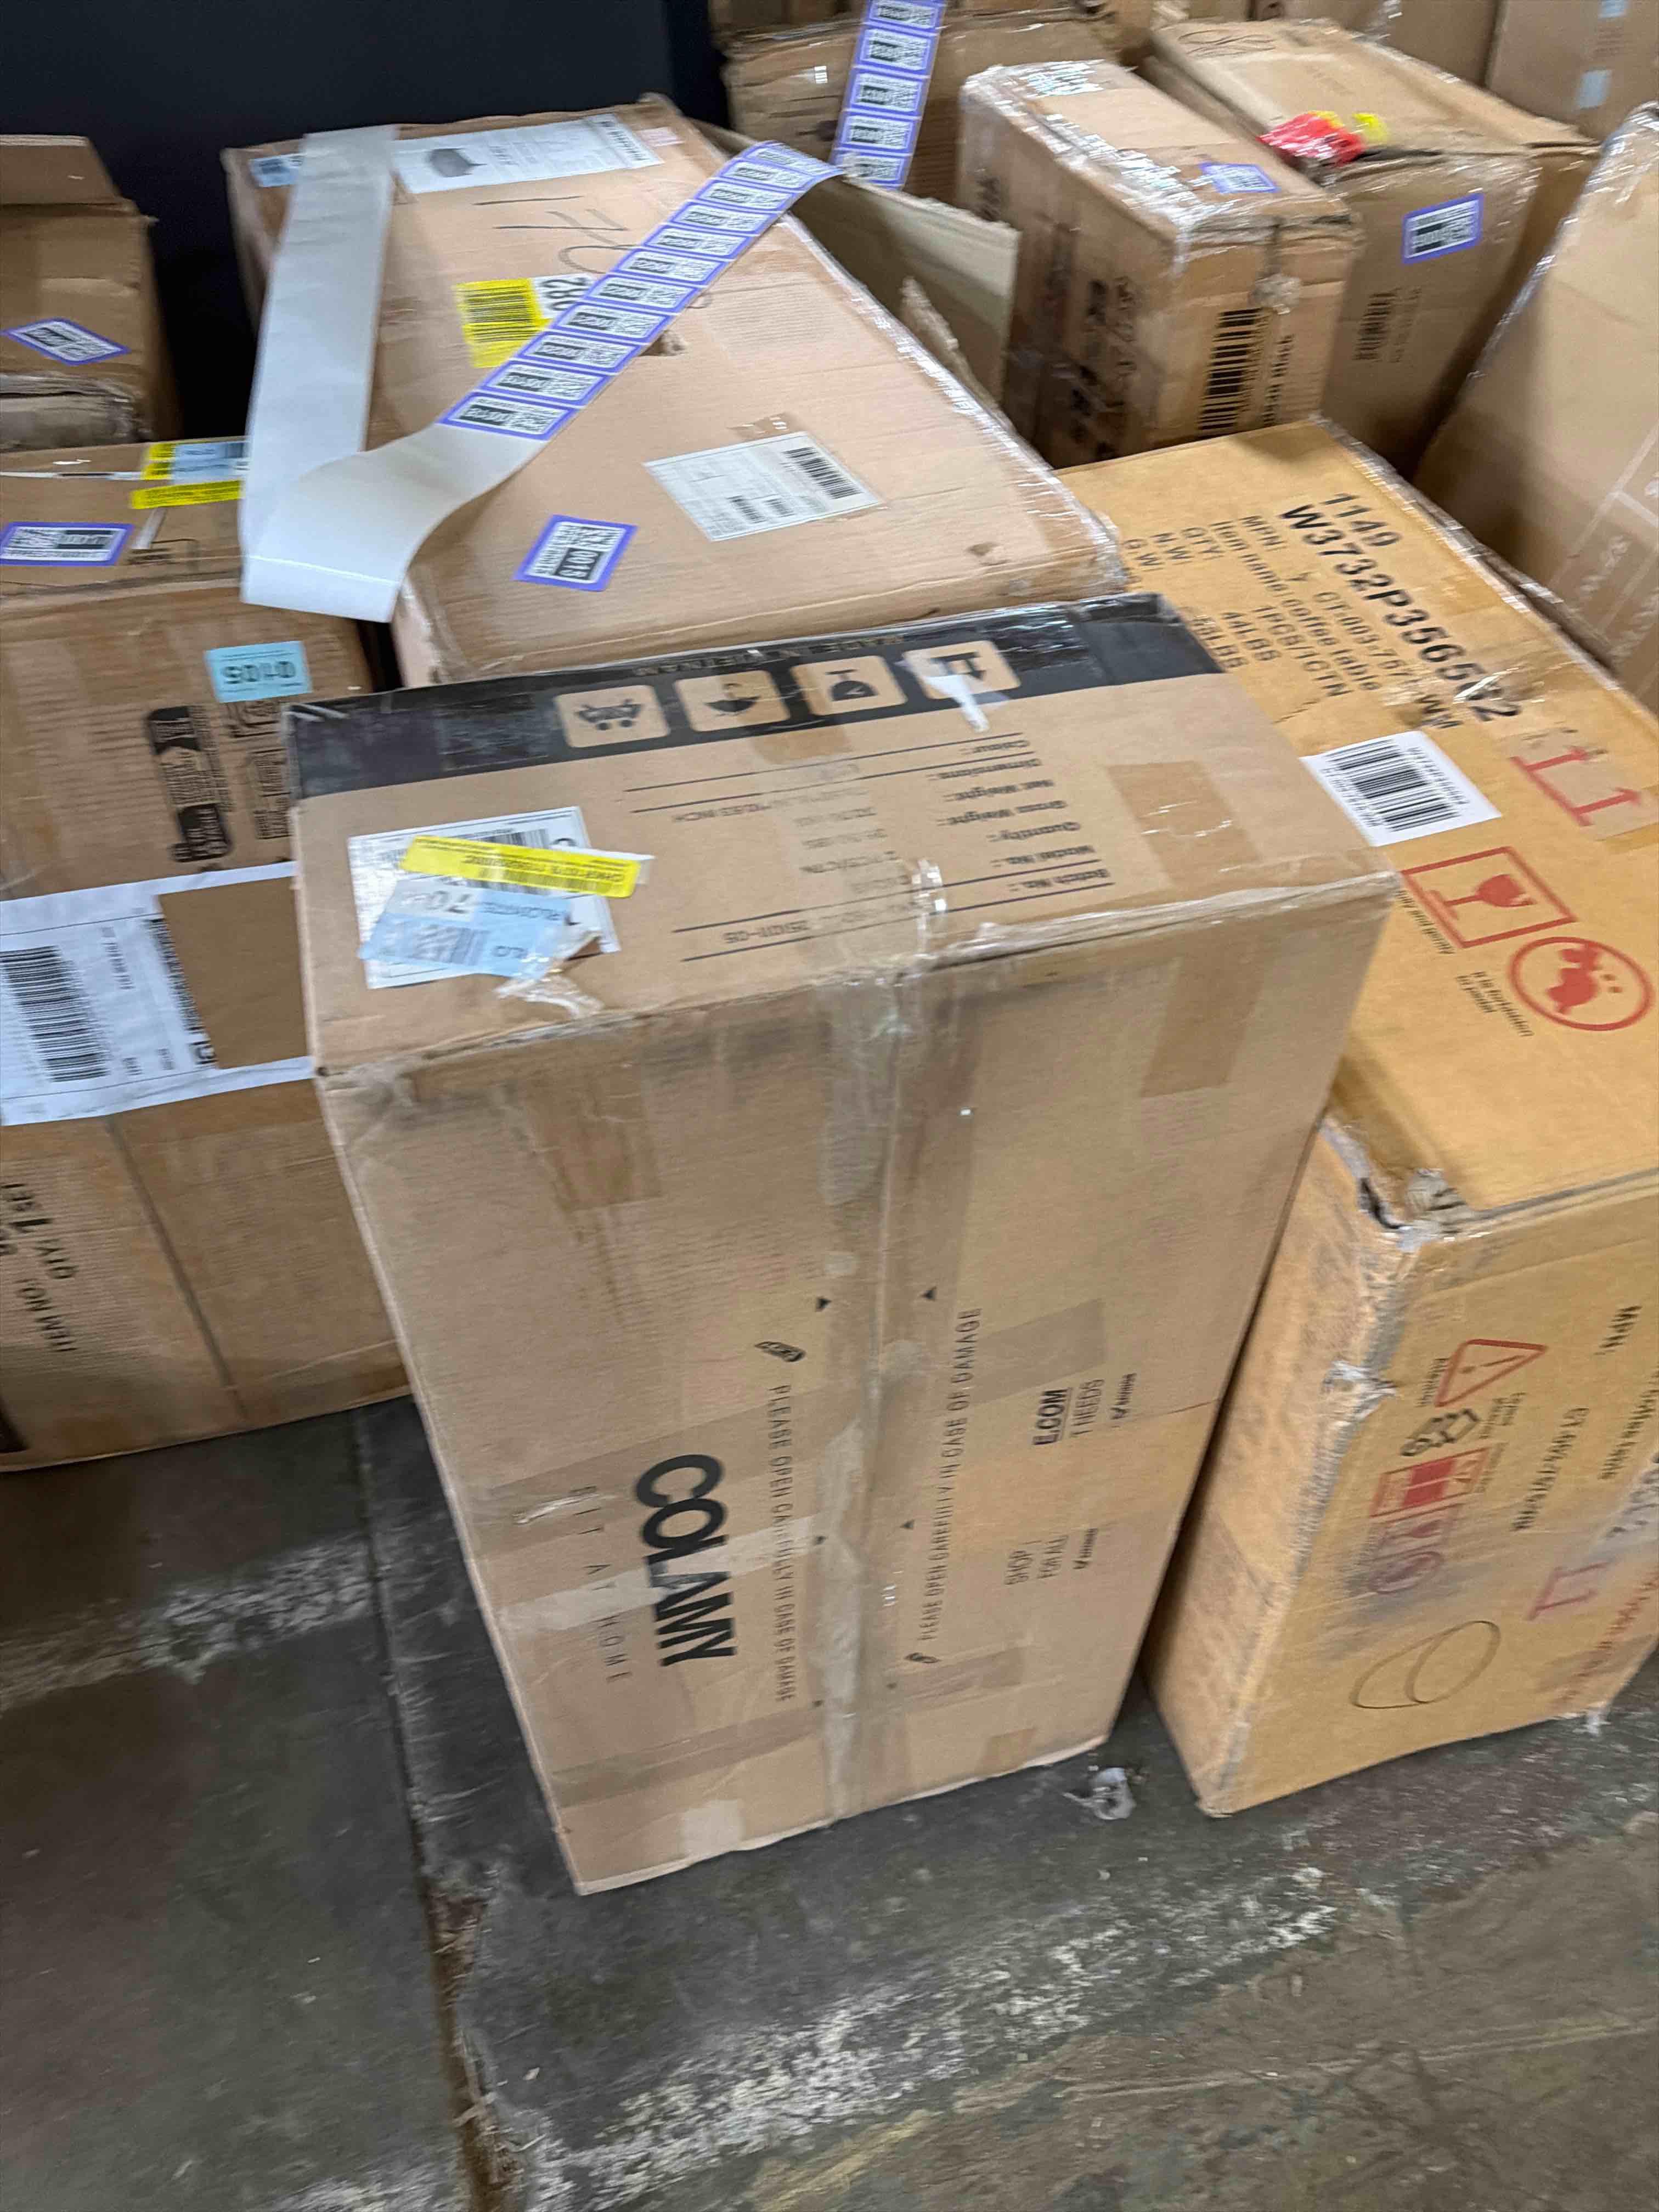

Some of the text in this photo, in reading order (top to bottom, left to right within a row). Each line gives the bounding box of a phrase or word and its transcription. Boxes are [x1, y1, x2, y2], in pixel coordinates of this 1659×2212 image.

[1318, 493, 1402, 547] 1149
[950, 1308, 983, 1384] DAMAGE
[768, 1385, 792, 1448] PLEASE
[946, 1391, 971, 1411] OF
[940, 1417, 968, 1458] CASE
[769, 1456, 793, 1498] OPEN
[939, 1463, 961, 1479] IN
[636, 1454, 738, 1667] COLAMY
[773, 1585, 795, 1600] IN
[774, 1604, 795, 1635] CASE
[775, 1655, 796, 1701] DAMAGE
